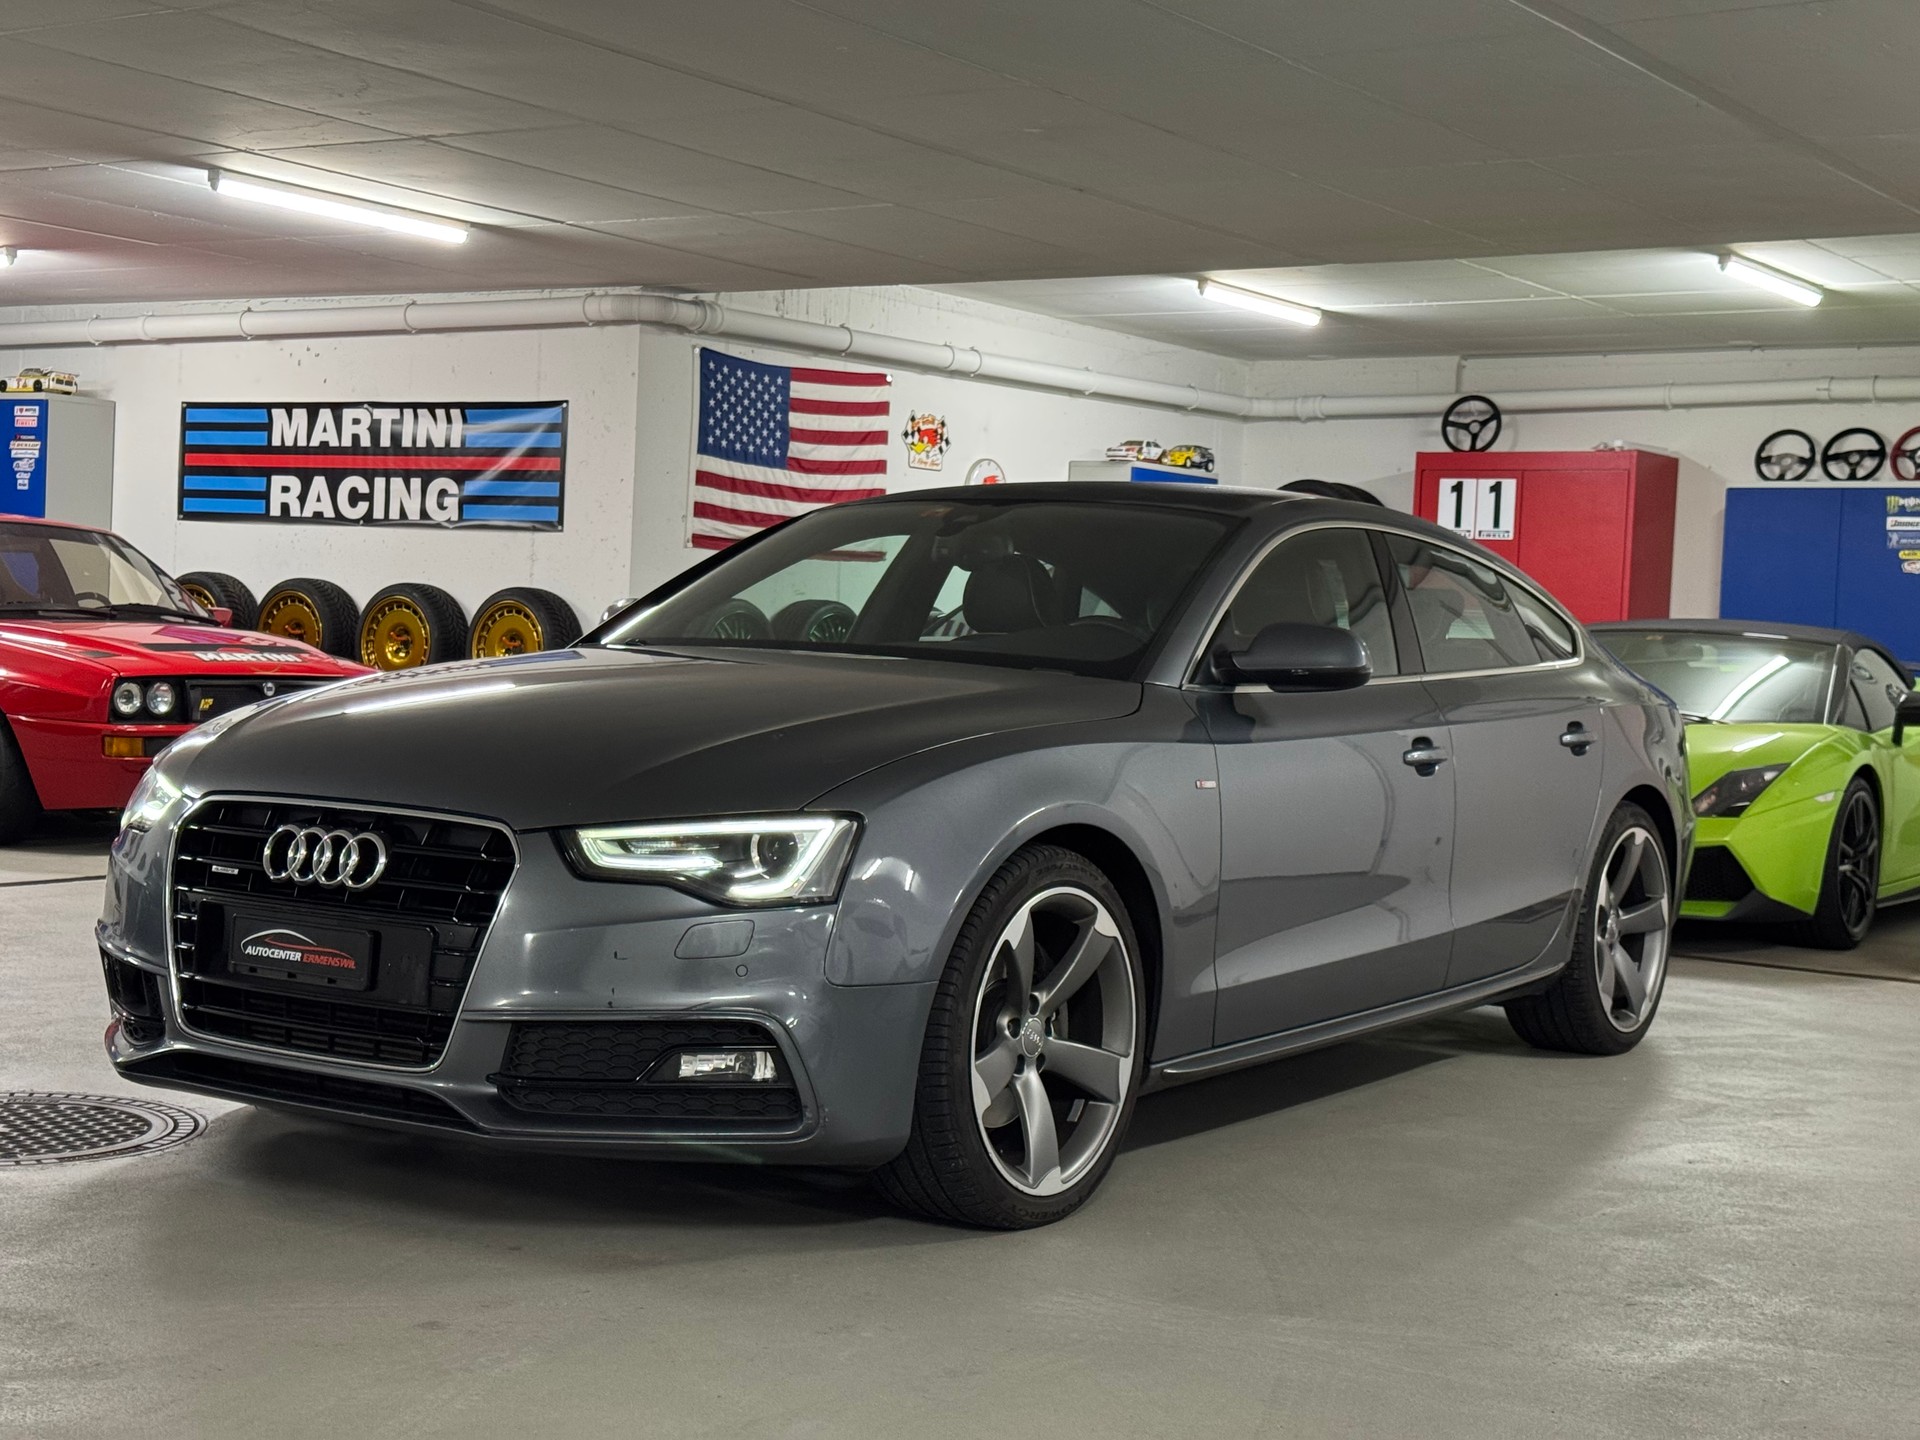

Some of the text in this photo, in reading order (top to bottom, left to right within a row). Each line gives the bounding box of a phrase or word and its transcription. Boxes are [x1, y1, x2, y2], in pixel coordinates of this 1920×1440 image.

[271, 408, 463, 448] MARTINI
[269, 475, 460, 521] RACING
[194, 652, 303, 662] MARTINI
[245, 945, 356, 969] AUTOCENTER ERMENSWIL
